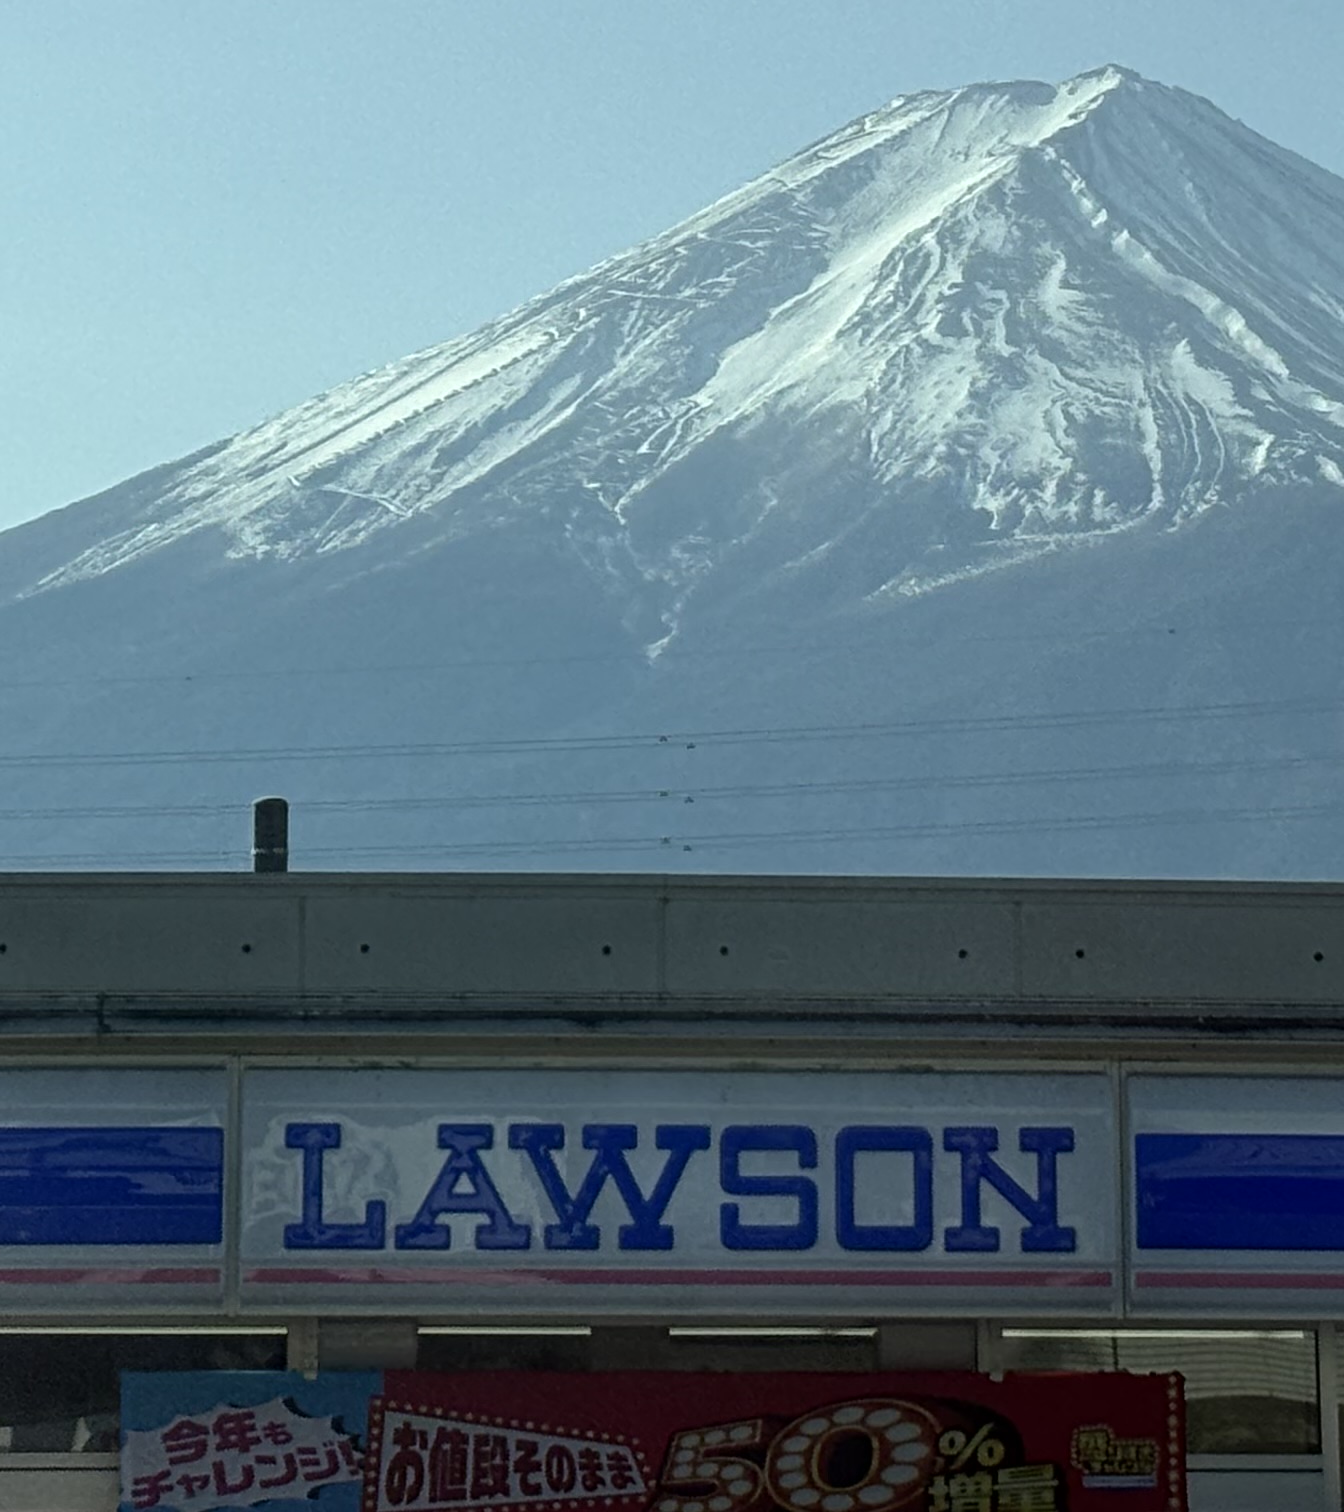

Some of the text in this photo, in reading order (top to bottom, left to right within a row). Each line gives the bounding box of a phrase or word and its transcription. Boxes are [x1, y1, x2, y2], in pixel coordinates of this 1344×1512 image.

[284, 1122, 1076, 1252] LAWSON
[130, 1439, 360, 1510] チャレンジ!
[161, 1410, 294, 1466] 今年も
[385, 1420, 638, 1506] お値段そのまま
